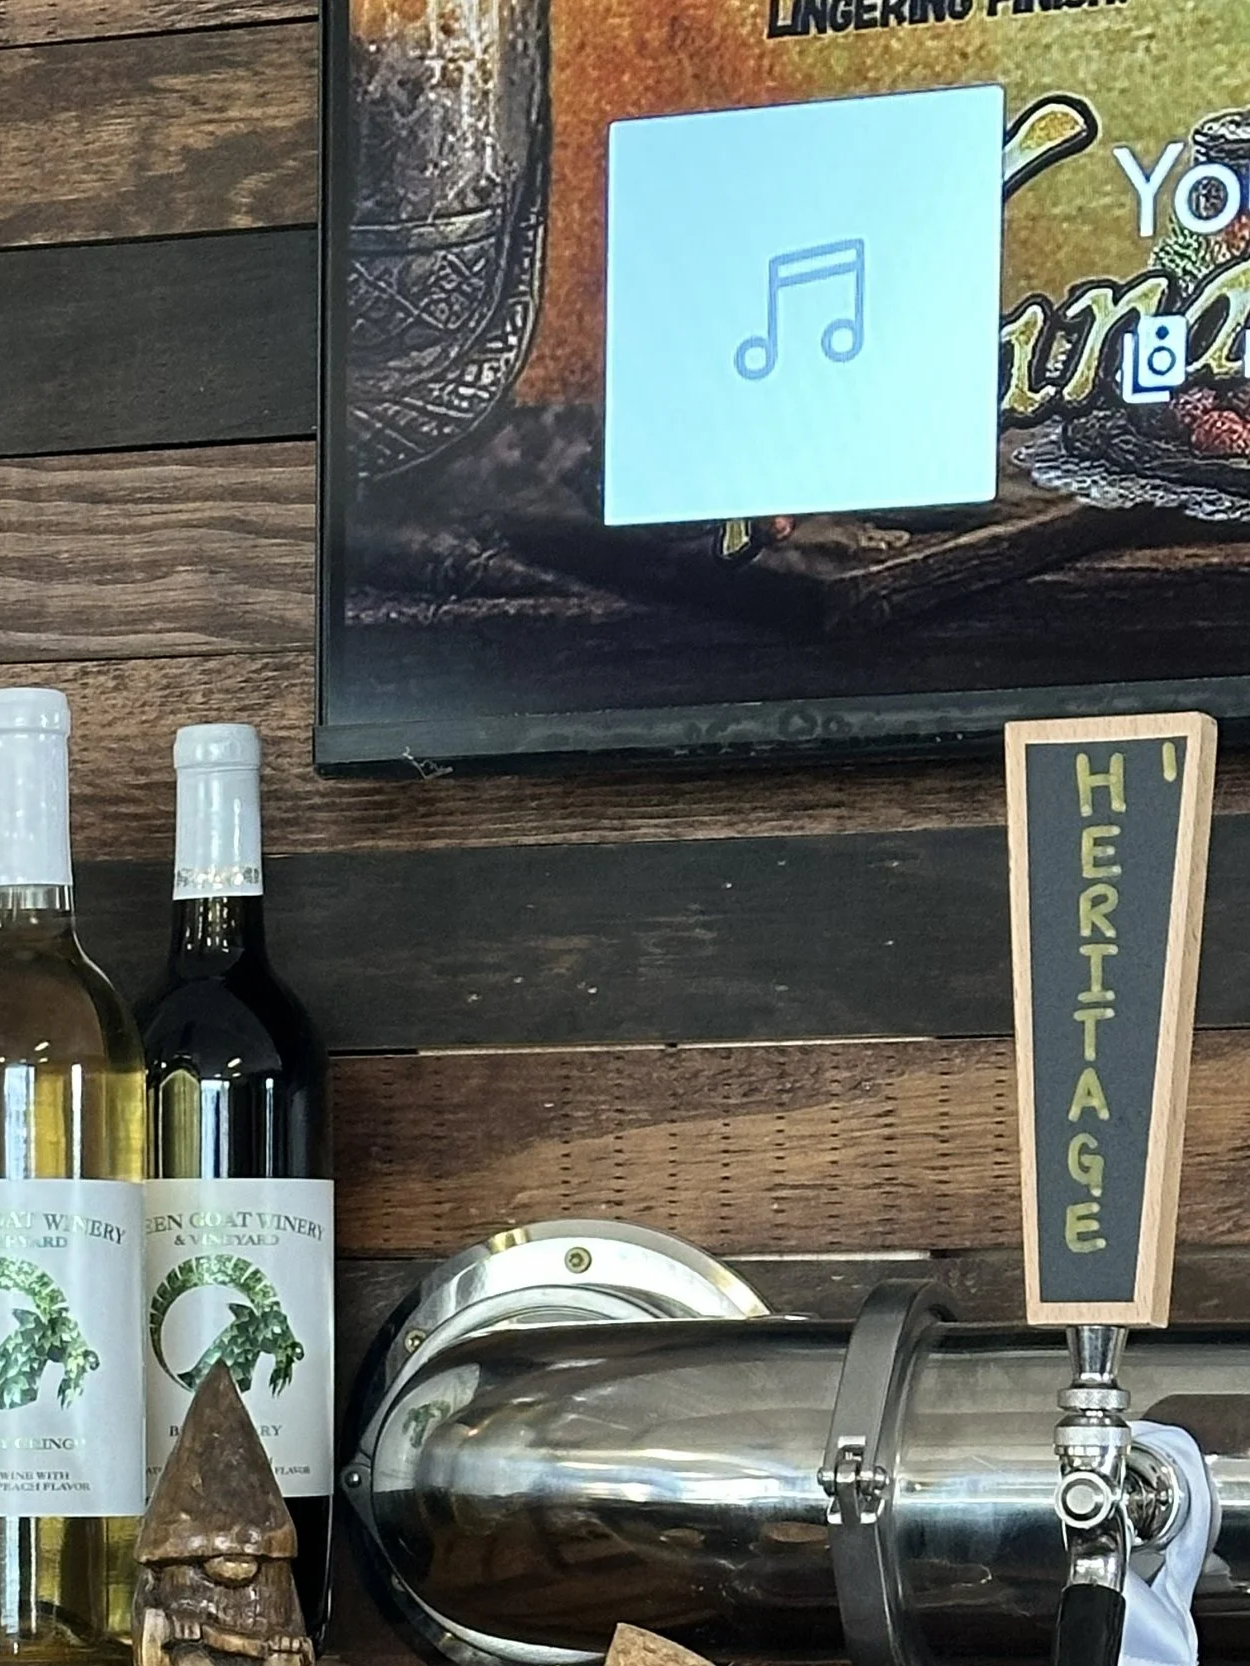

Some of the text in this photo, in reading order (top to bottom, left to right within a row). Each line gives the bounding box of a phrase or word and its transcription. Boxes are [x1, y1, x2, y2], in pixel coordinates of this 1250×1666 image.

[1113, 141, 1250, 237] YO
[1063, 752, 1126, 1255] HERITAGE
[43, 1212, 126, 1245] WINERY
[174, 1235, 186, 1246] &
[189, 1211, 253, 1229] GOAT
[255, 1212, 325, 1241] WINERY
[0, 1472, 33, 1480] WINE
[36, 1472, 70, 1480] WITH
[43, 1482, 90, 1491] FLAVOR
